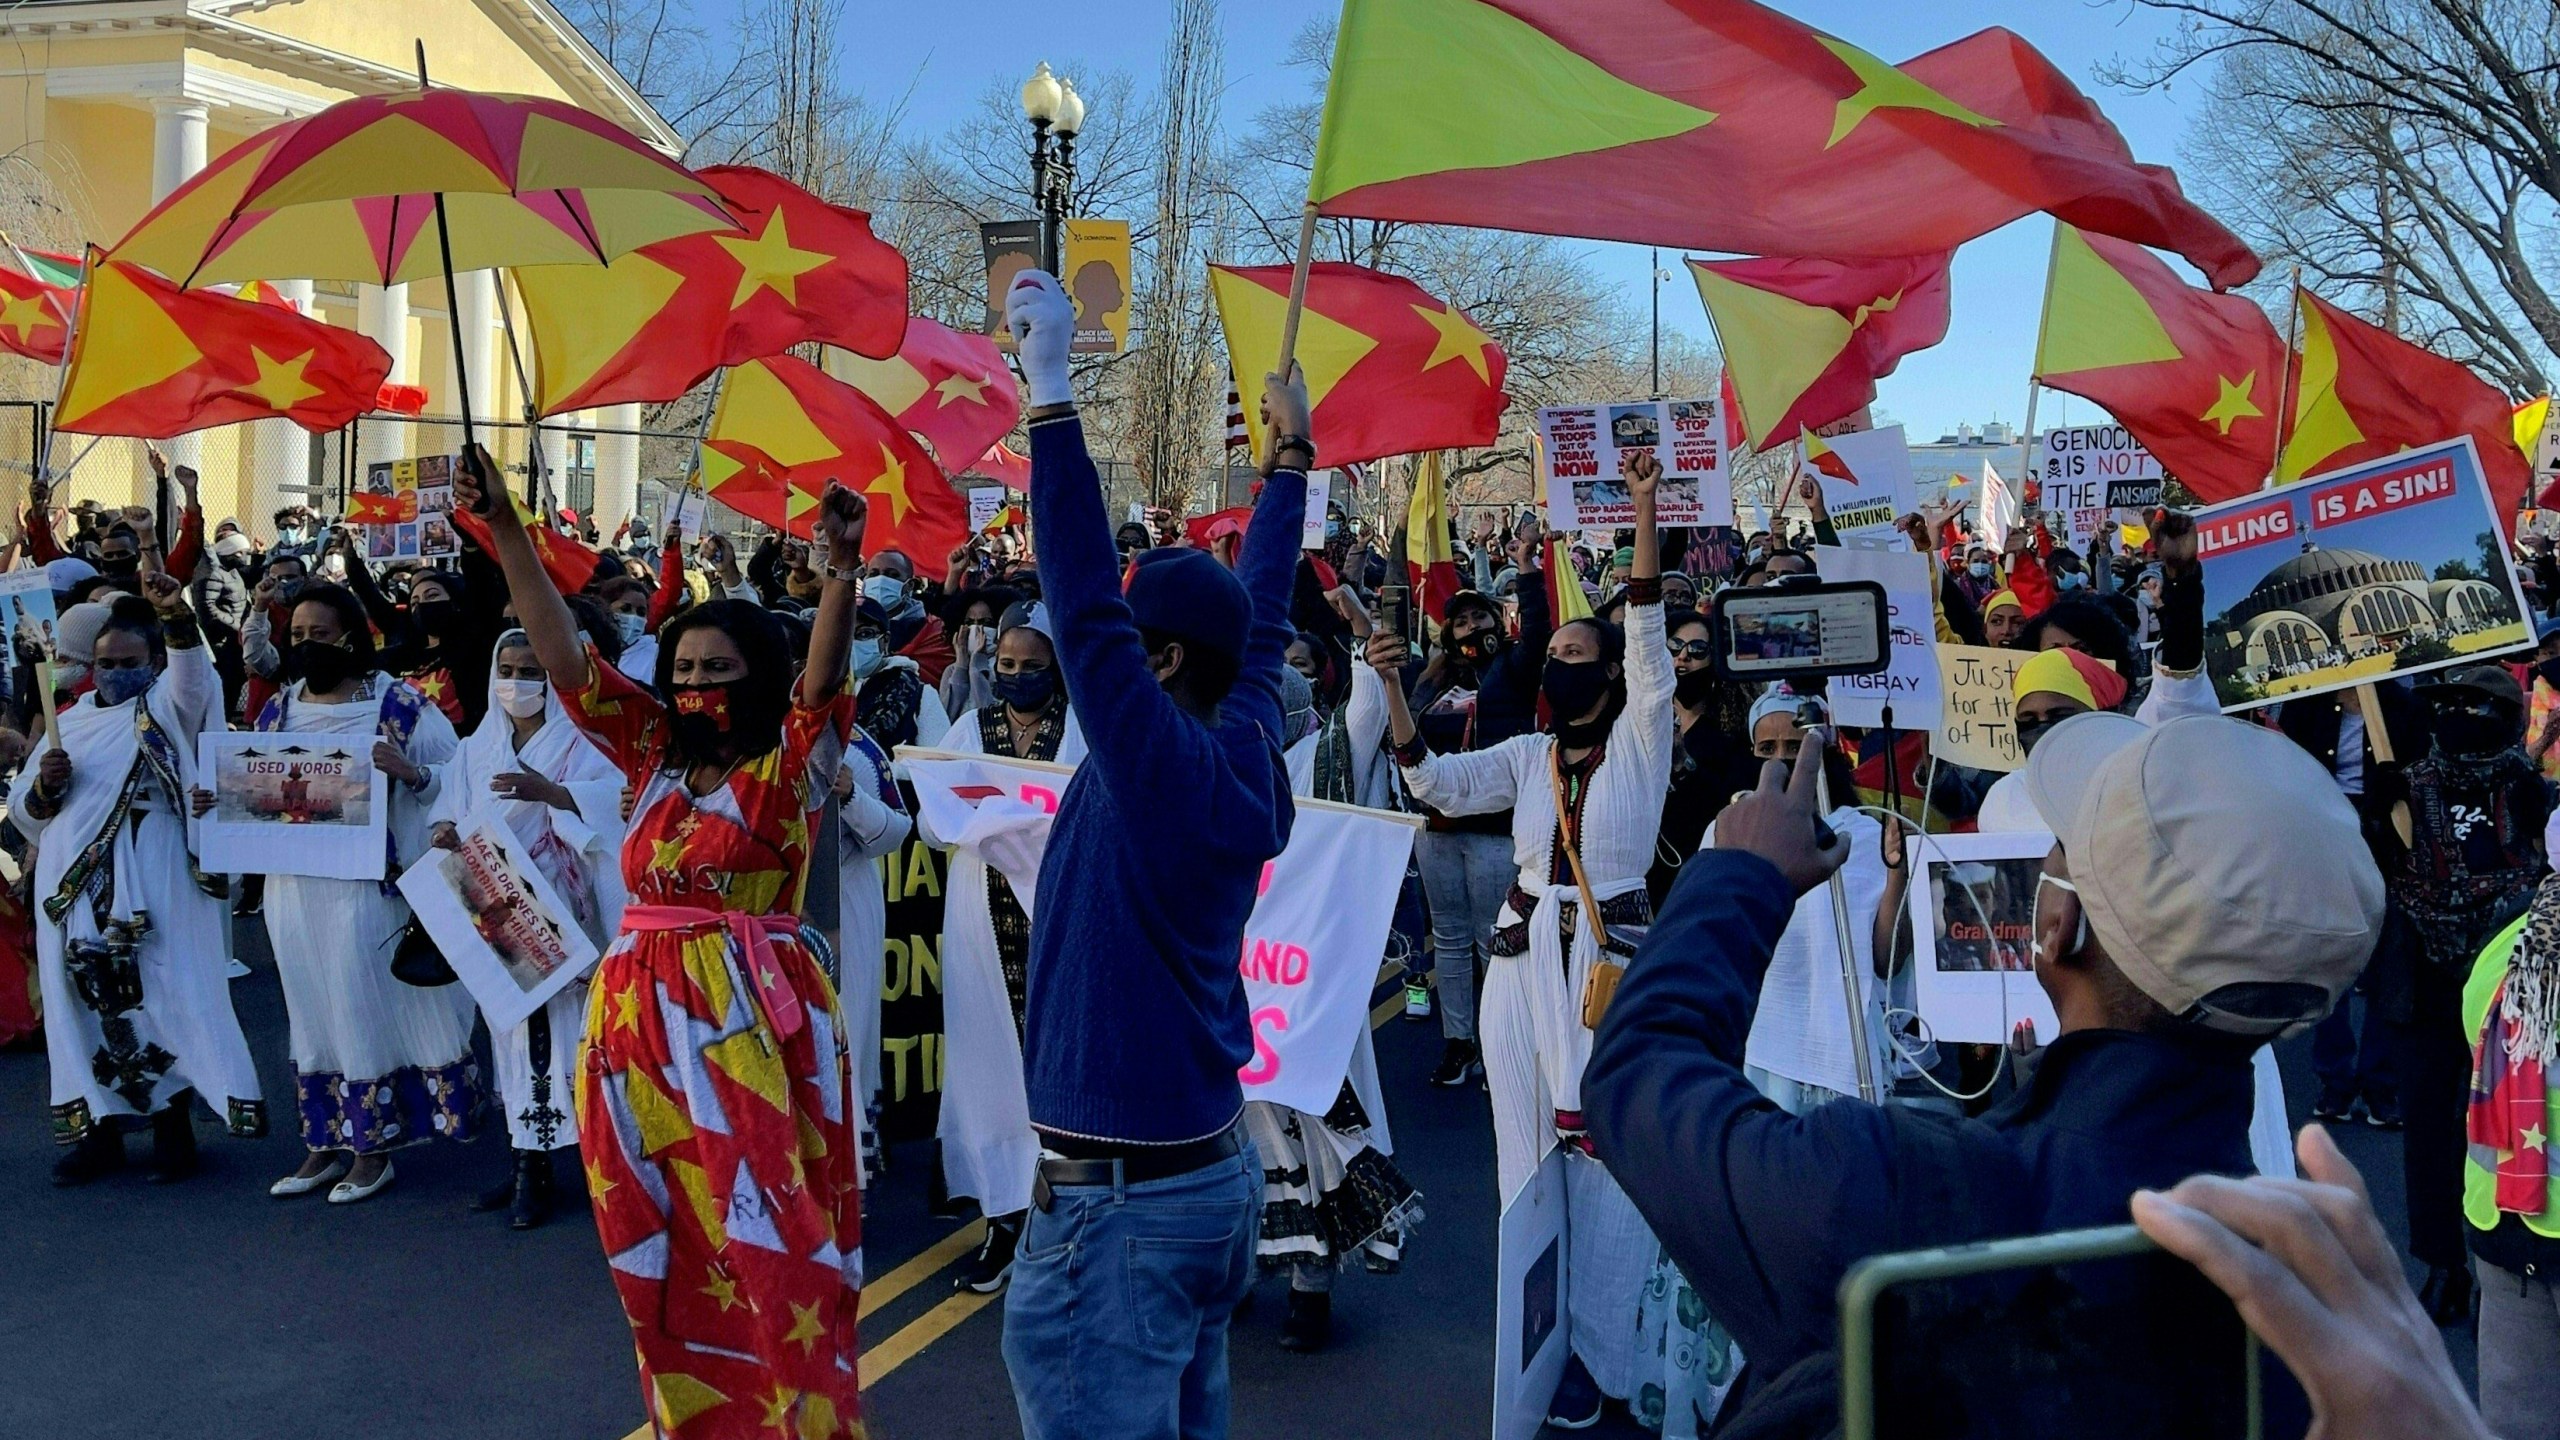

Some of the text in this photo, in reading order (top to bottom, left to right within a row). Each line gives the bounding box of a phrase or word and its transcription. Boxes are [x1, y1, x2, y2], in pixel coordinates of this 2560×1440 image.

[1676, 419, 1709, 431] STOP
[1551, 431, 1596, 442] TROOPS
[1552, 450, 1595, 461] TIGRAY
[1676, 455, 1716, 471] NOW
[2067, 453, 2151, 477] IS NOT
[1553, 461, 1598, 477] NOW
[1843, 498, 1869, 510] MILLION
[1870, 495, 1892, 506] PEOPLE
[2048, 482, 2097, 509] THE
[1578, 505, 1601, 514] STOP
[1655, 503, 1683, 512] EGARU
[1686, 503, 1704, 511] LIFE
[2197, 467, 2449, 553] ILLING IS A SIN!
[1598, 516, 1636, 524] CHILDRE
[1655, 514, 1698, 523] MATTERS
[1833, 507, 1892, 530] STARVING
[1954, 658, 2016, 691] Just
[1951, 691, 1980, 714] for
[1948, 720, 2021, 761] of Tig
[247, 762, 343, 775] USED WORDS
[473, 833, 568, 961] UAE'S DRONES STOP
[509, 916, 555, 973] HILDREN
